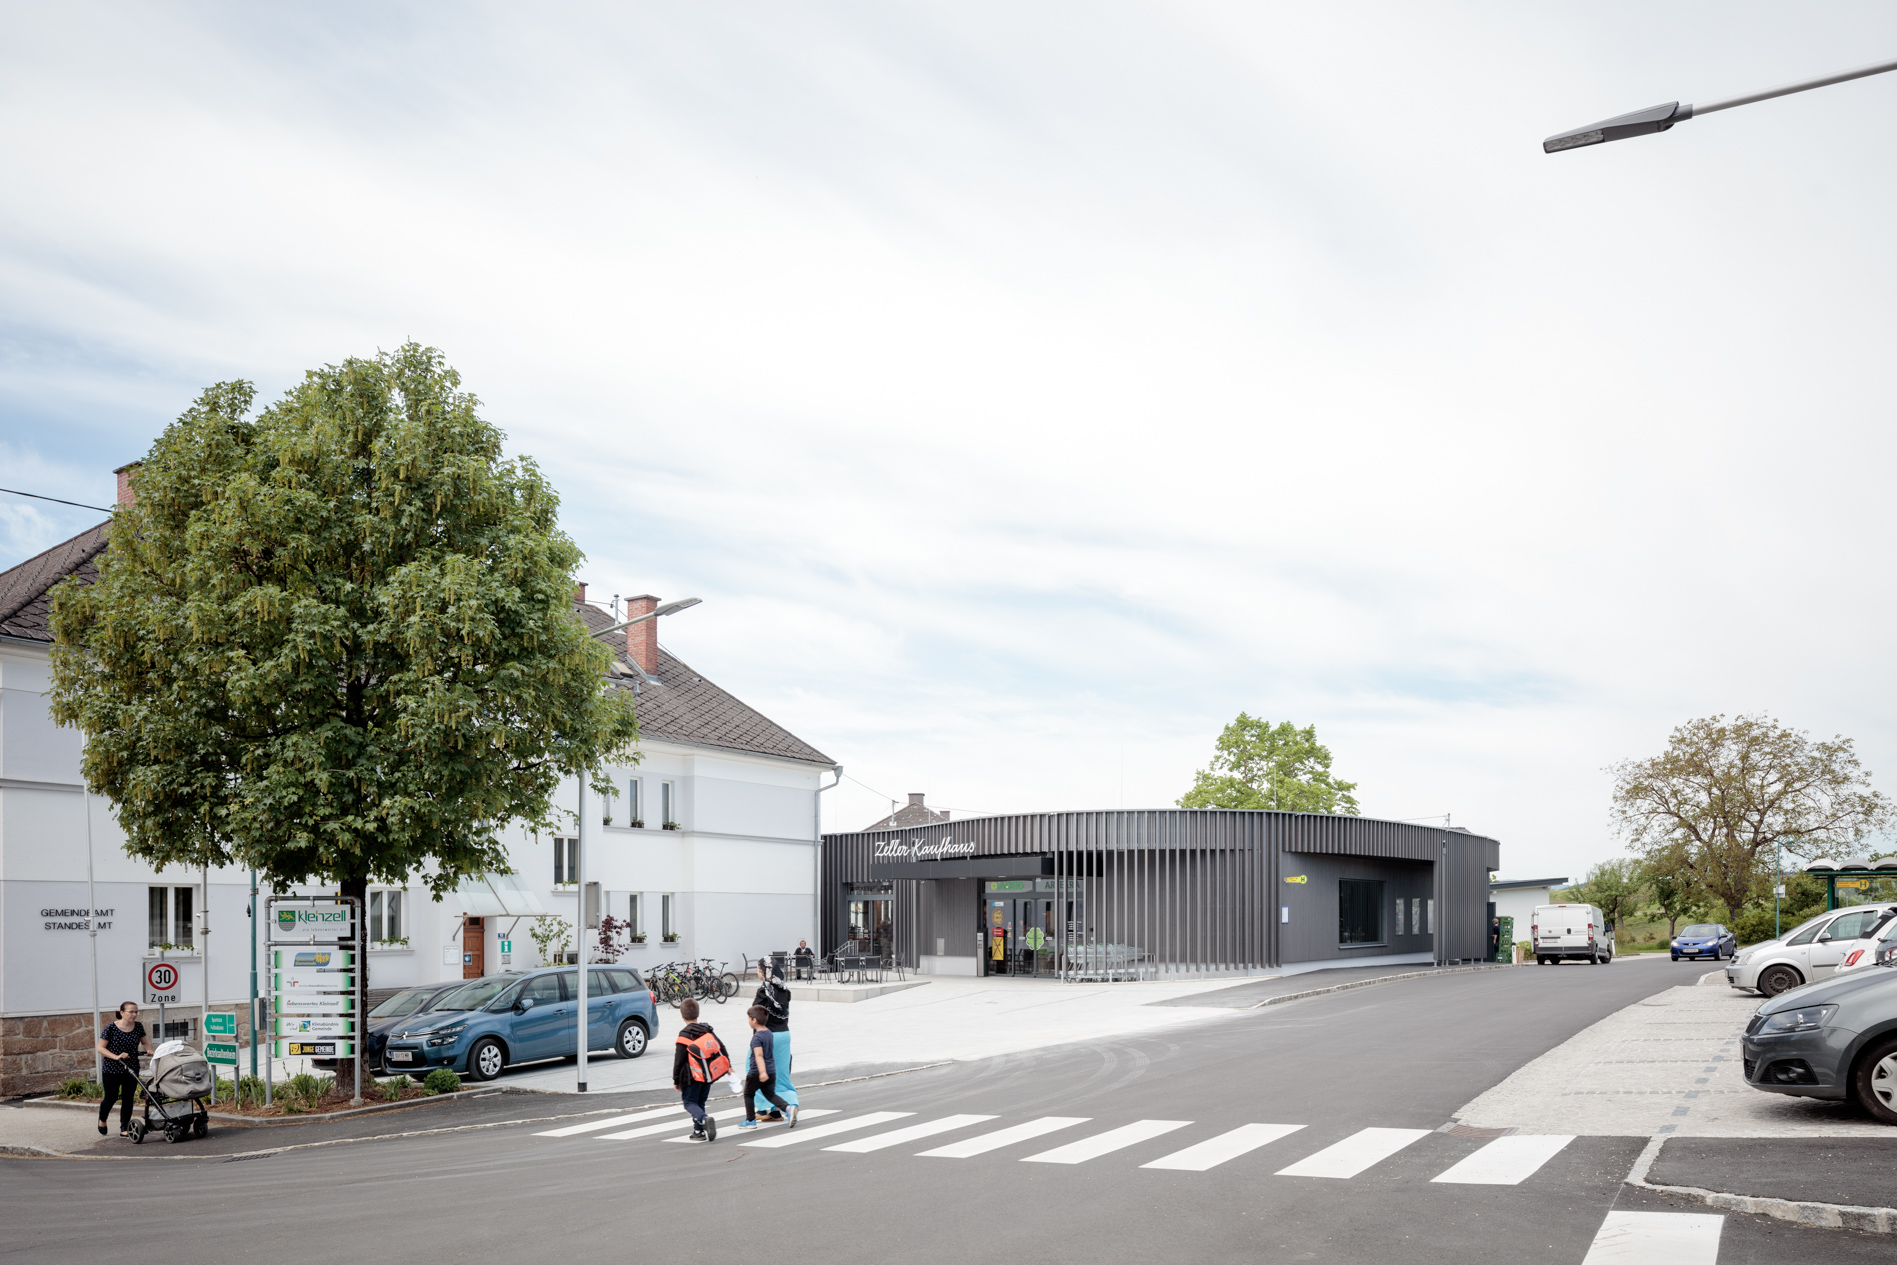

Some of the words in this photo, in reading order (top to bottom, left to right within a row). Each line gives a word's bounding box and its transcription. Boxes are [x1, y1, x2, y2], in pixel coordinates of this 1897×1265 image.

[875, 839, 911, 857] Zeller
[911, 836, 975, 861] Kaufhaus
[998, 881, 1024, 891] ADEG
[44, 921, 113, 931] STANDESMT
[155, 969, 171, 985] 30
[150, 993, 176, 1003] Zone
